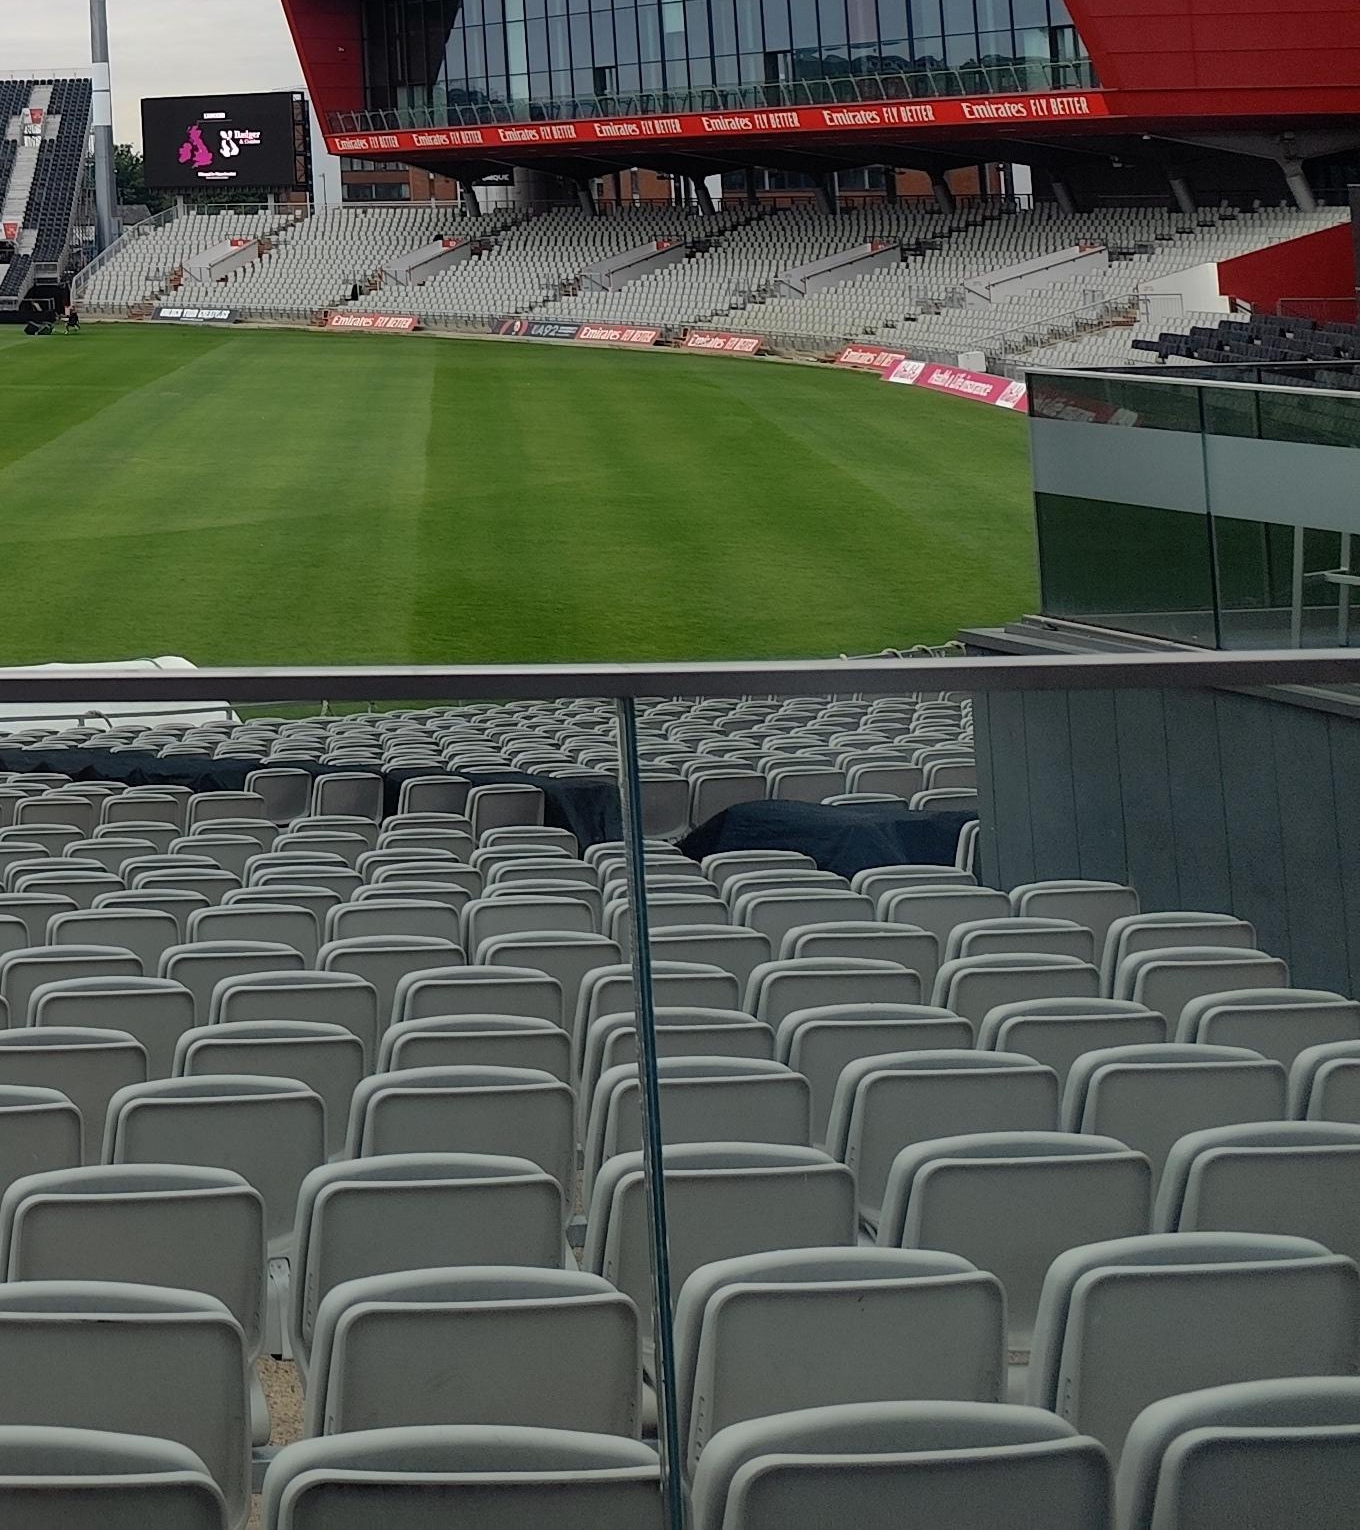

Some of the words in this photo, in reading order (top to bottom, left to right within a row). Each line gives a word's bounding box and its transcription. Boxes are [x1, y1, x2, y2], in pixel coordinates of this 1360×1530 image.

[822, 109, 881, 126] Emirates
[882, 107, 899, 123] FLY
[900, 105, 935, 122] BETTER
[961, 101, 1027, 119] Emirates
[1030, 98, 1048, 116] FLY
[1050, 96, 1090, 116] BETTER
[594, 123, 640, 138] Emirates
[640, 120, 655, 135] FLY
[654, 118, 682, 134] BETTER
[701, 116, 752, 132] Emirates
[754, 113, 769, 129] FLY
[770, 111, 800, 128] BETTER
[412, 133, 449, 146] Emirates
[450, 132, 462, 145] FLY
[460, 131, 483, 144] BETTER
[498, 128, 539, 142] Emirates
[540, 126, 553, 140] FLY
[553, 125, 576, 139] BETTER
[334, 138, 368, 151] Emirates
[332, 315, 374, 327] Emirates
[580, 327, 622, 340] Emirates
